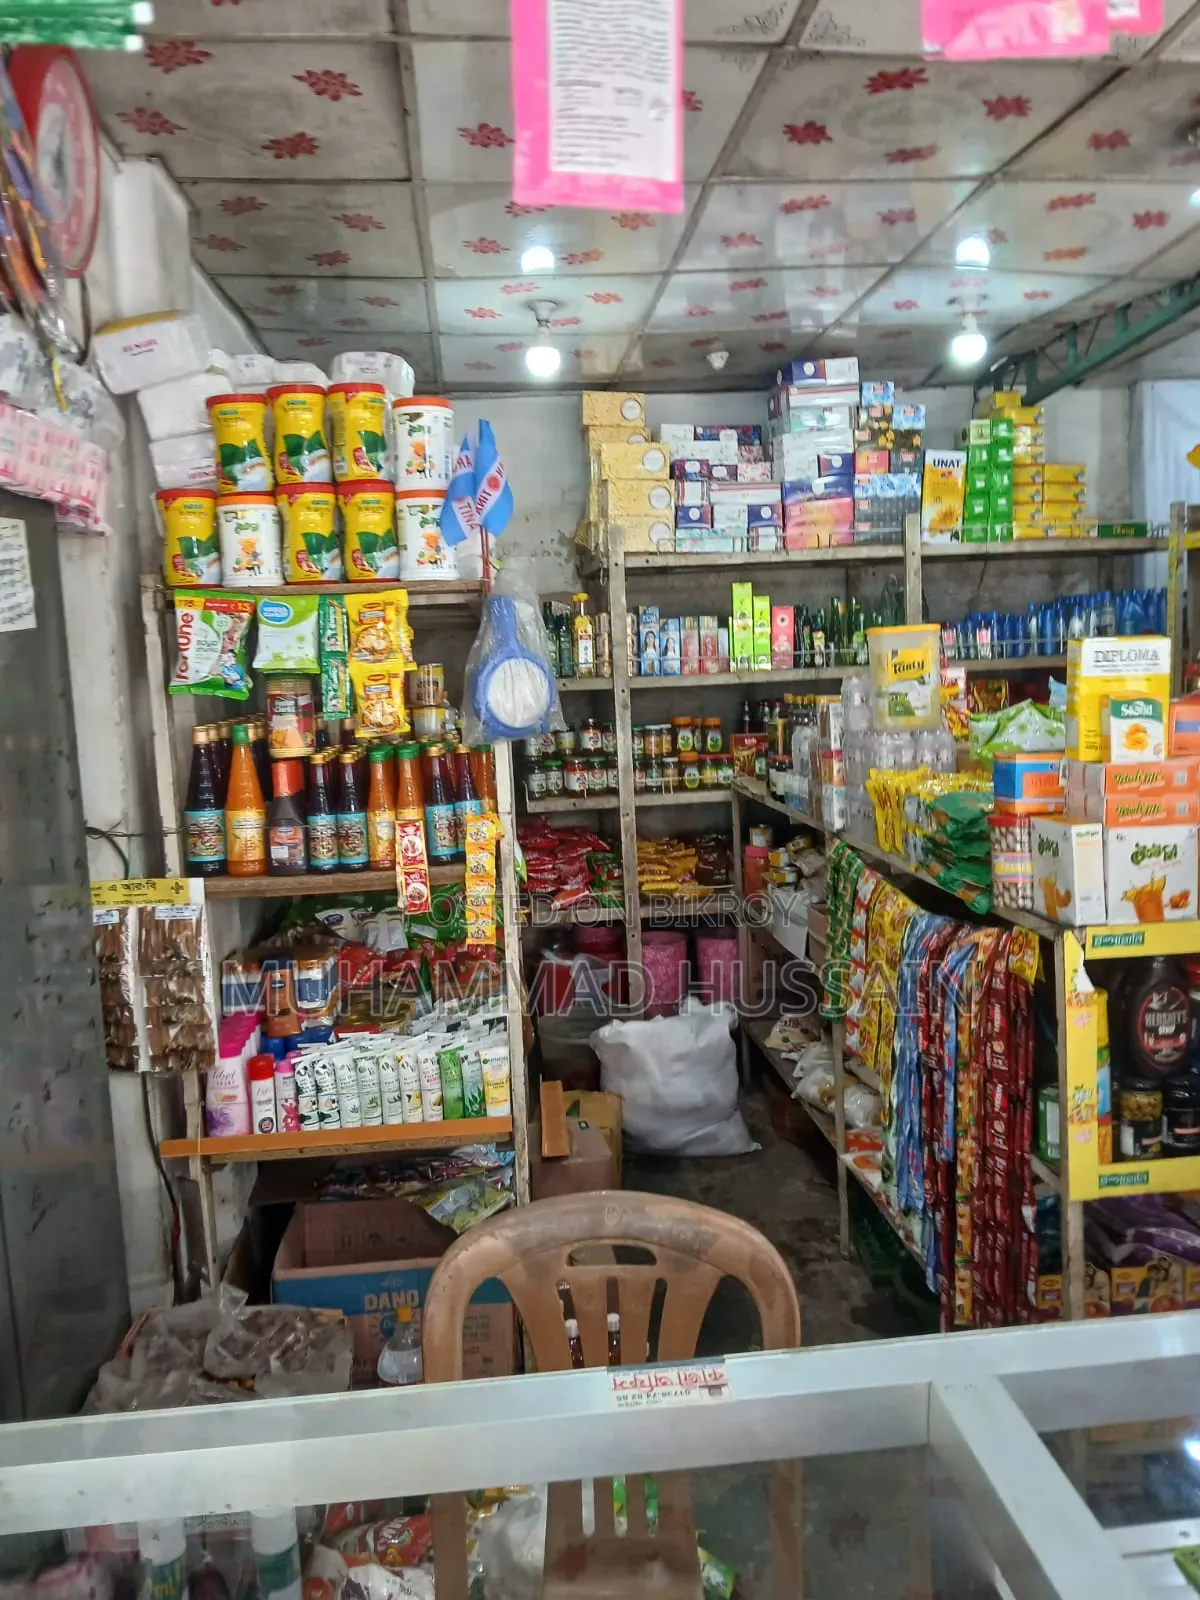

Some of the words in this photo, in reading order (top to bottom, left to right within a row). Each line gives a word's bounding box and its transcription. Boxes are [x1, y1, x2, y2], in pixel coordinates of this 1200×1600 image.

[1093, 648, 1160, 663] DIPLOMA
[1145, 1010, 1188, 1027] HERSHEY'S
[364, 1289, 420, 1311] DANO
